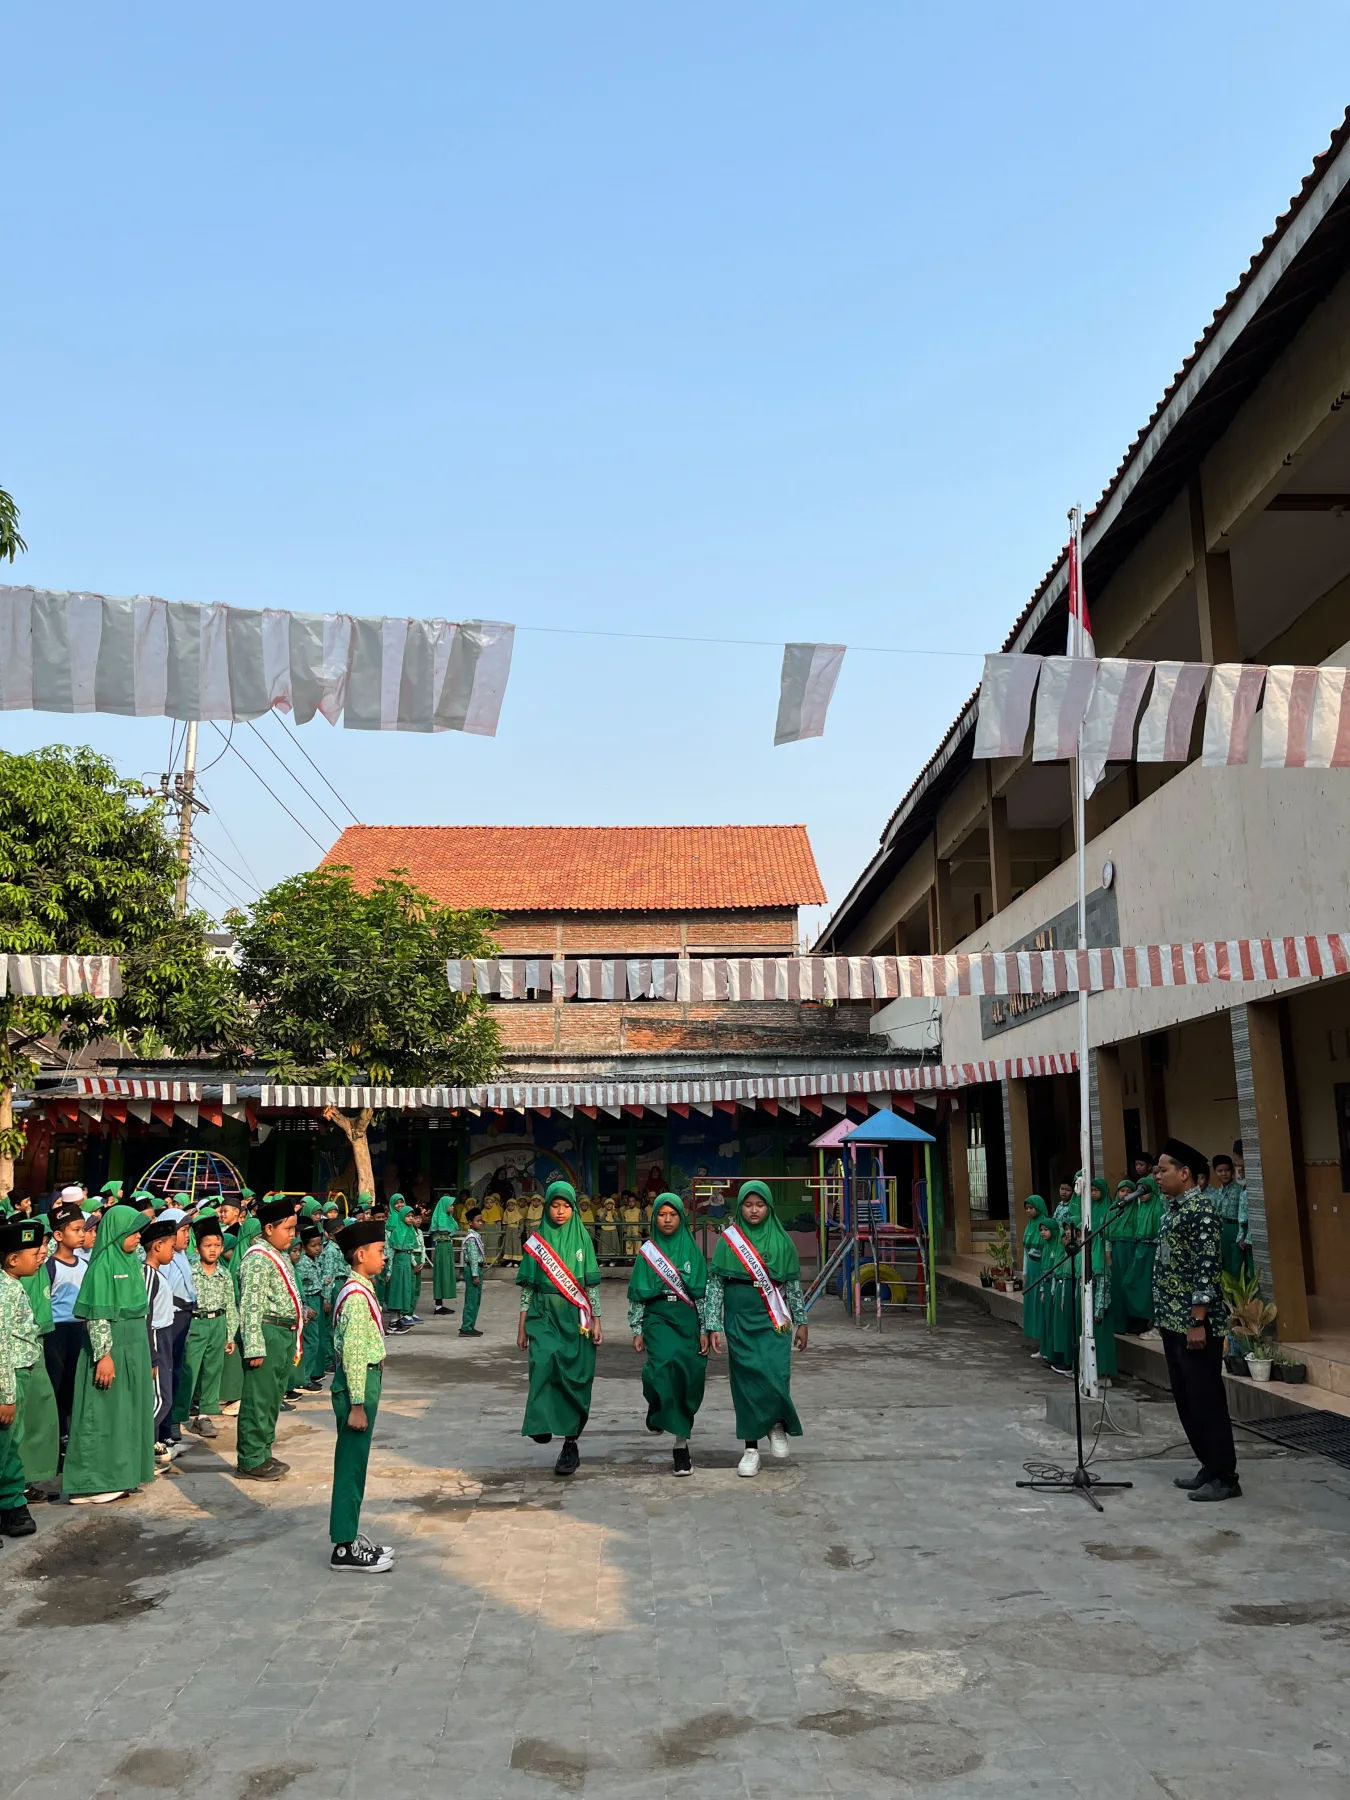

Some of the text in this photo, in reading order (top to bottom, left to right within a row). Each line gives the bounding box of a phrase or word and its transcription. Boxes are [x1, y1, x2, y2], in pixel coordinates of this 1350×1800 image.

[534, 1244, 579, 1298] PETUGAS UPACARA
[655, 1257, 679, 1284] PETUGAS
[739, 1244, 774, 1296] PETUGAS UPACARA
